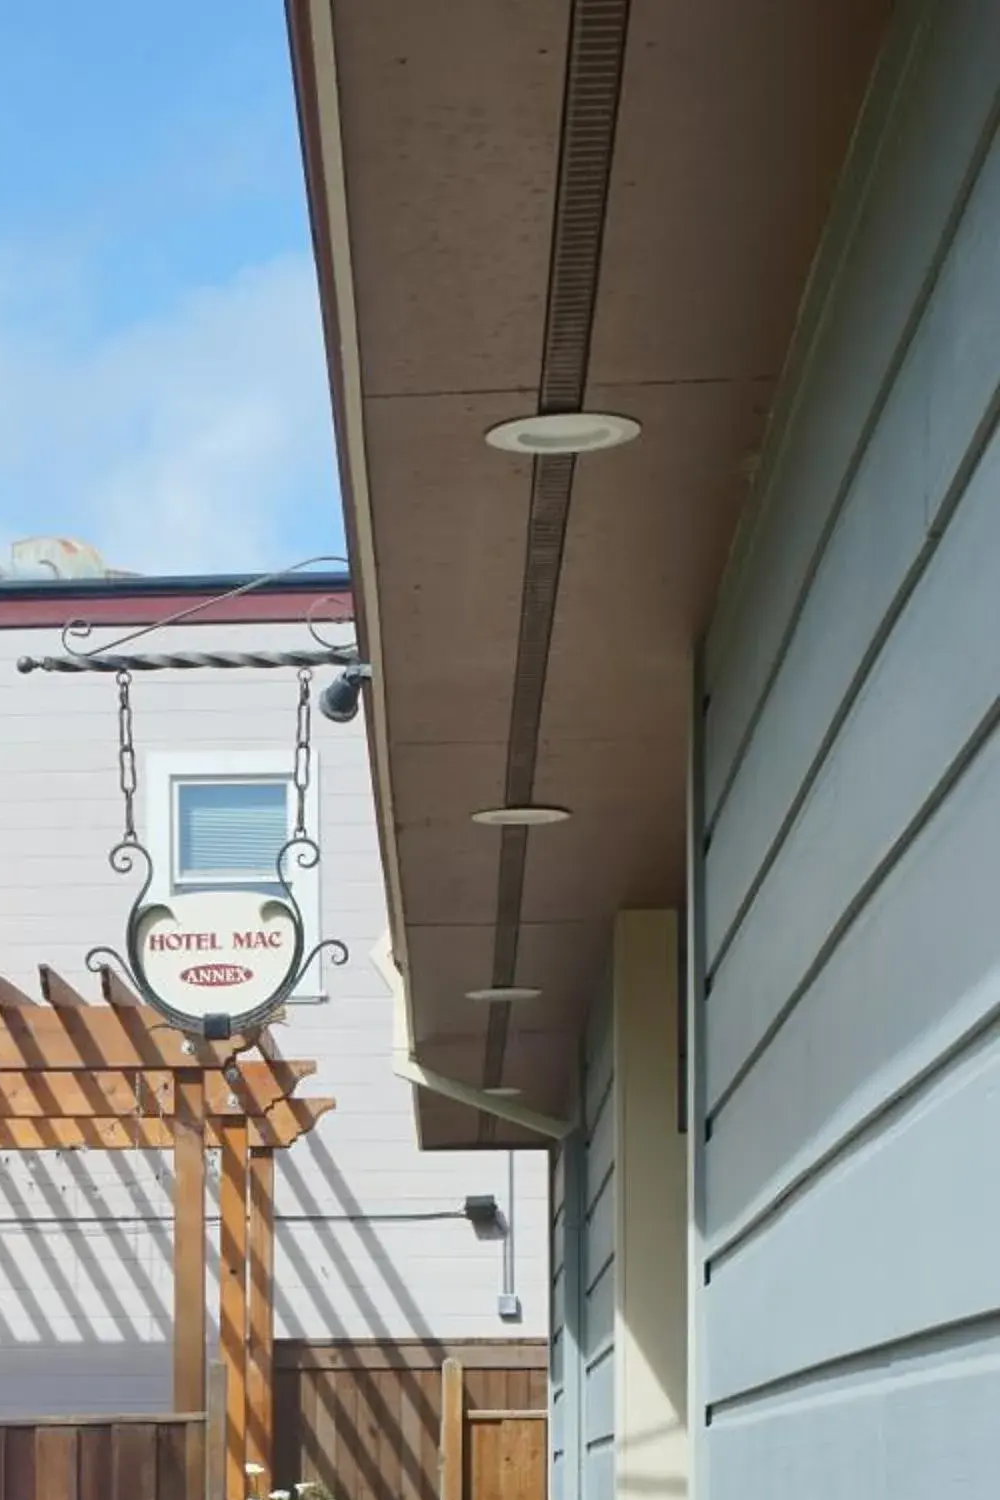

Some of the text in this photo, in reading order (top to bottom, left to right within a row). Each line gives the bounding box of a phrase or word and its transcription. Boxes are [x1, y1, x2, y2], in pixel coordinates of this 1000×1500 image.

[149, 931, 282, 951] HOTEL MAC
[186, 968, 247, 983] ANNEX
